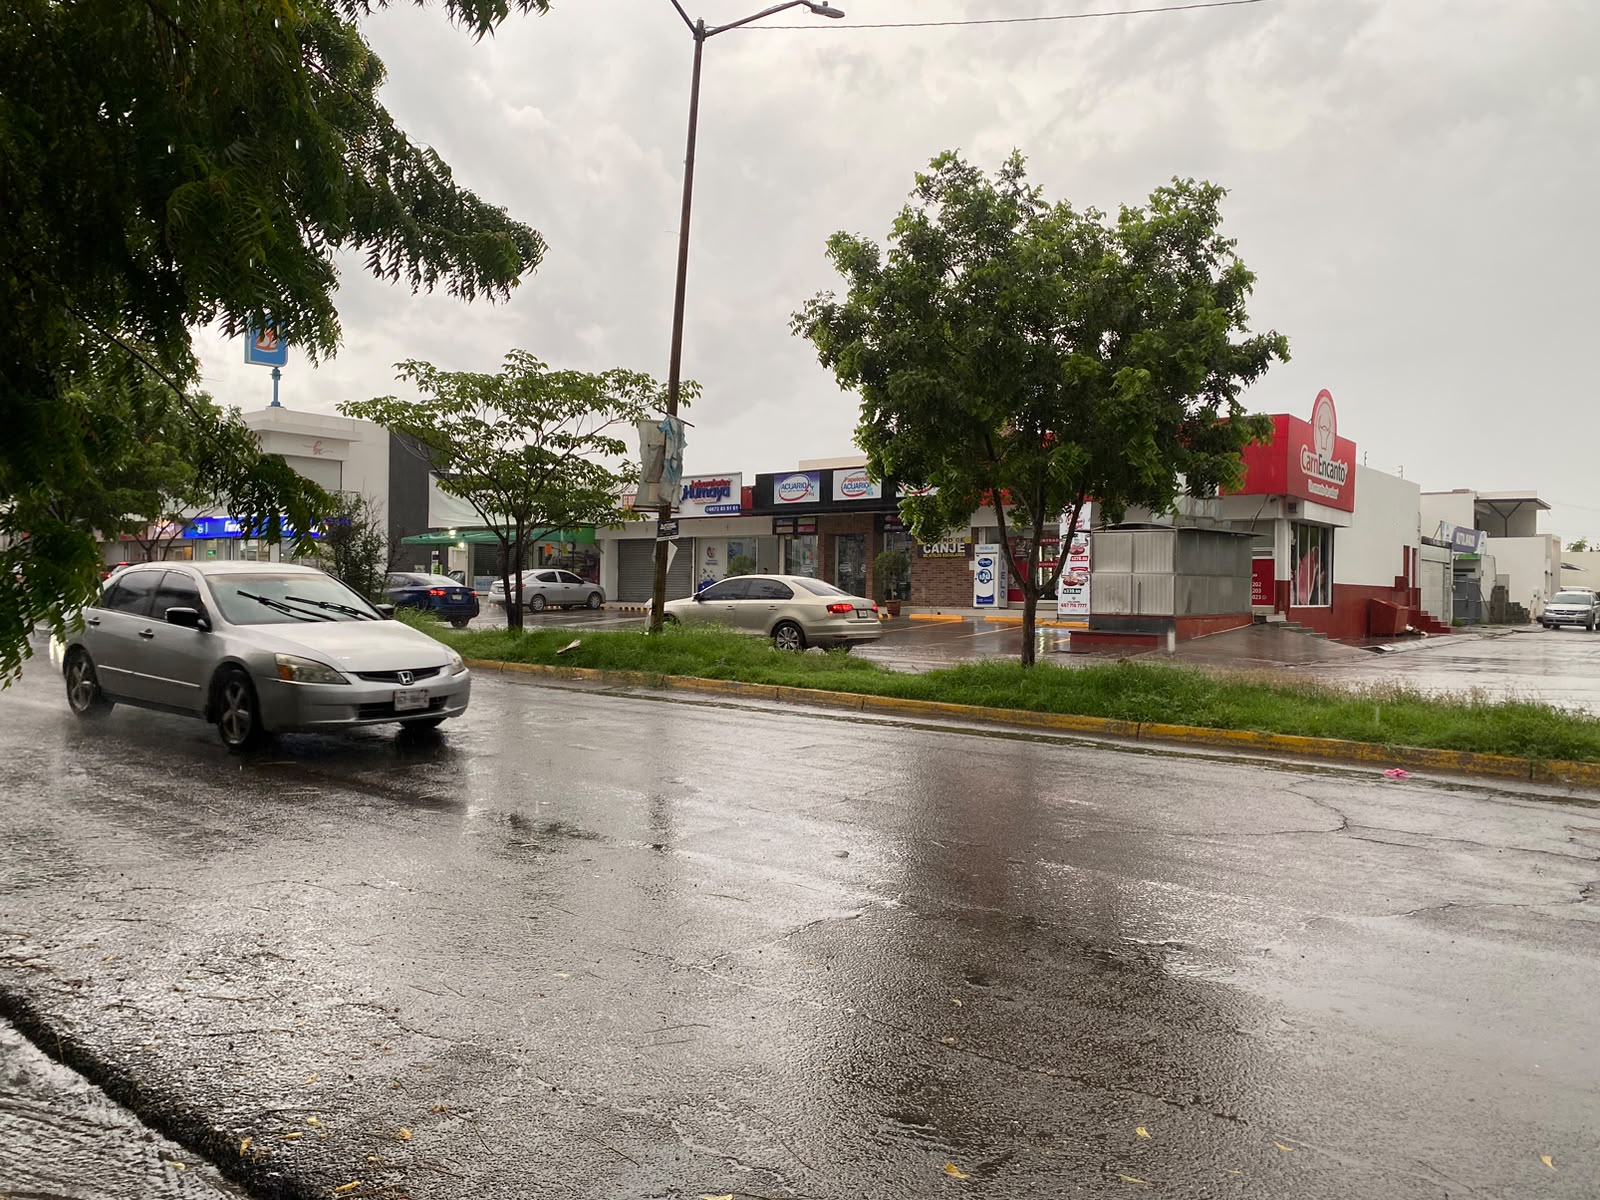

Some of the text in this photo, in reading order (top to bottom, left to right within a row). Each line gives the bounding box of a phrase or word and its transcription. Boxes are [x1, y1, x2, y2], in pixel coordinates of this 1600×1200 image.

[781, 482, 806, 490] ACUARIO
[843, 482, 868, 490] ACUARIO
[682, 485, 730, 501] Humaya
[922, 542, 966, 553] CANJE
